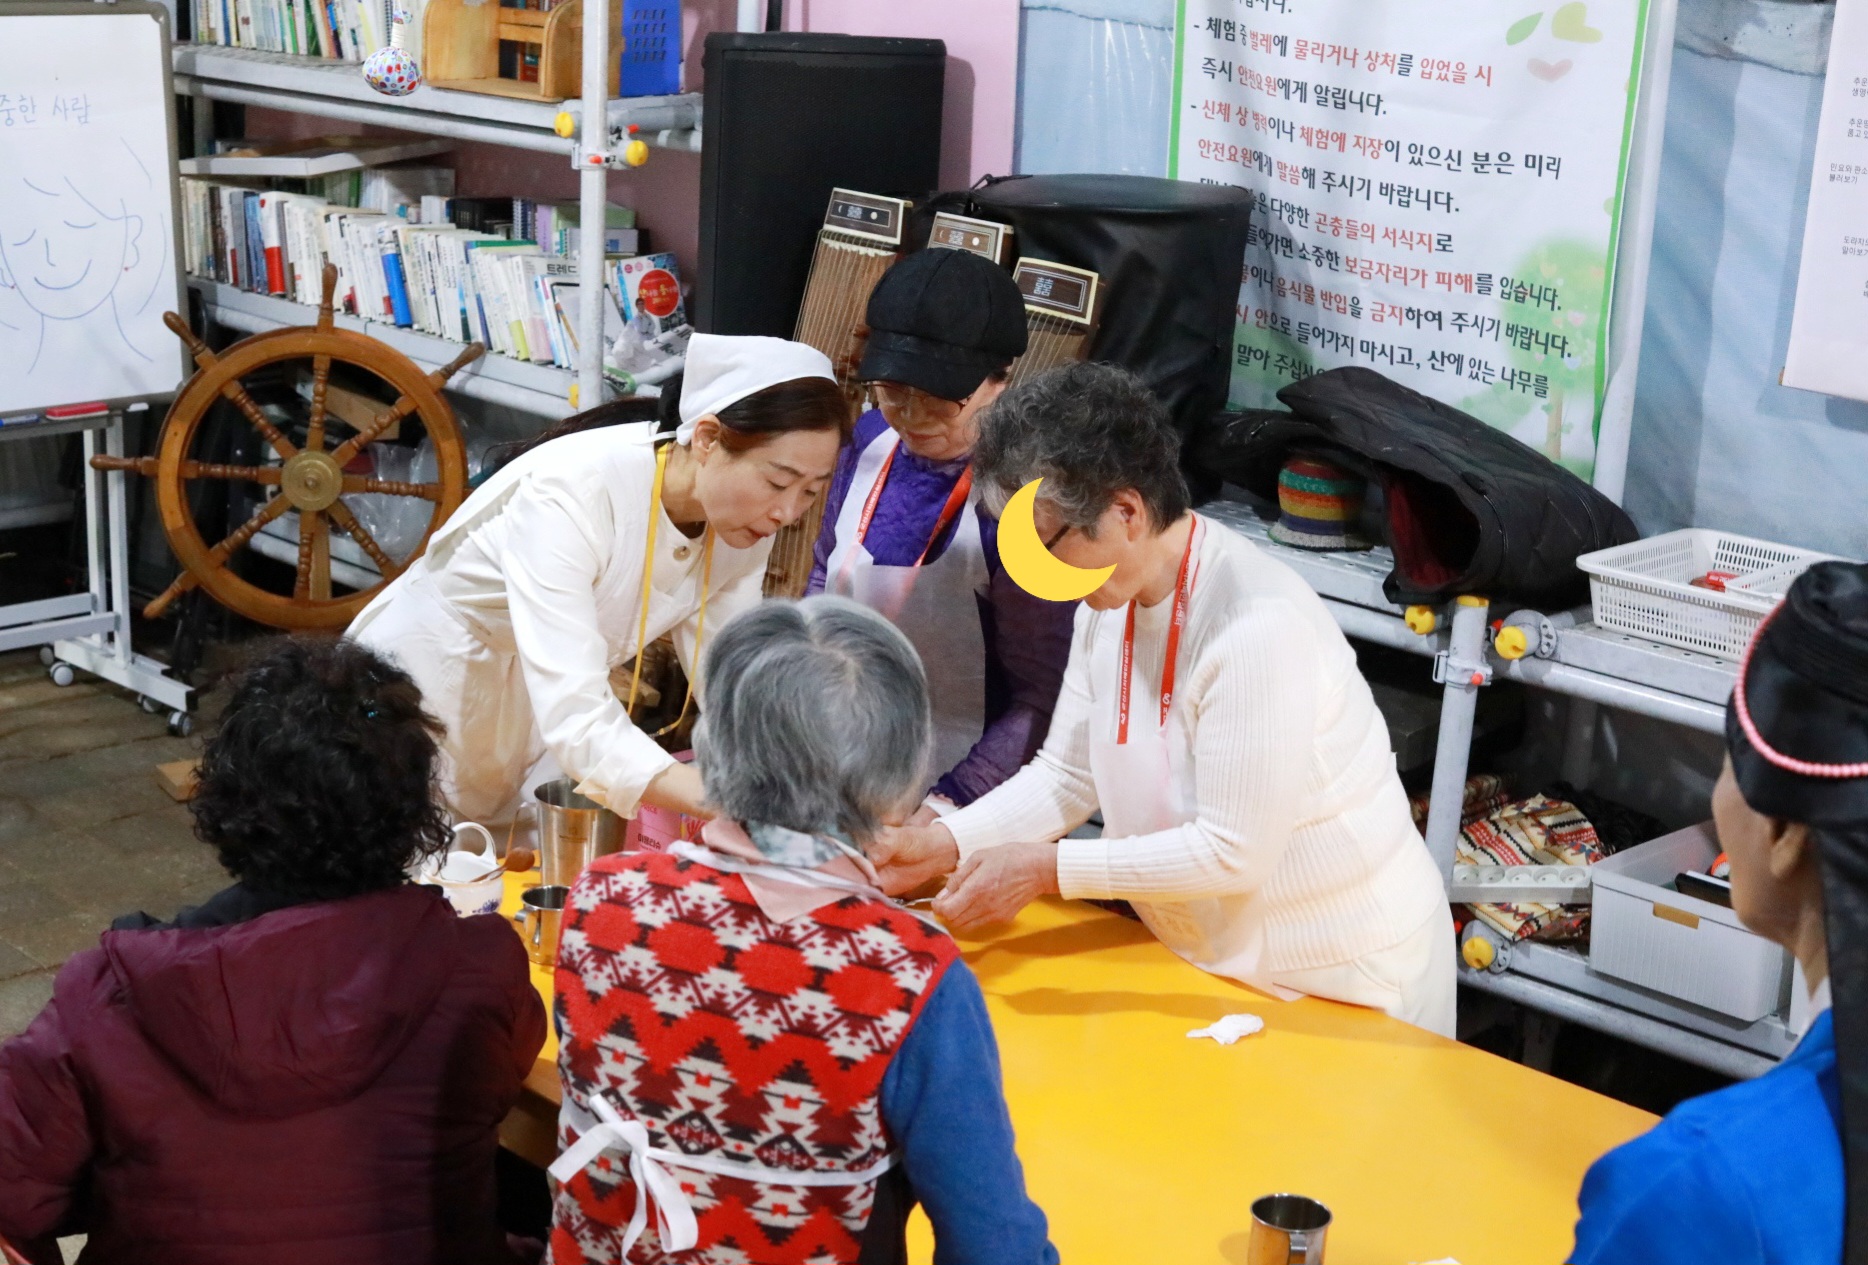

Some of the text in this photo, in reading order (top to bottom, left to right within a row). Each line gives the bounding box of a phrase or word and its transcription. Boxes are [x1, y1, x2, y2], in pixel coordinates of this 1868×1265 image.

[1202, 57, 1387, 116] 즉시 안전요원에게 알립니다.
[1206, 16, 1236, 42] 체험
[1249, 30, 1288, 57] 벌레에
[1294, 38, 1359, 68] 물리거나
[1364, 50, 1413, 77] 상처를
[1420, 58, 1467, 84] 입었을
[1474, 65, 1492, 87] 시
[52, 93, 91, 125] 사람
[1202, 99, 1231, 122] 신체
[1236, 106, 1249, 127] 상
[1299, 125, 1347, 153] 체험에
[1352, 134, 1400, 163] 지장이
[1407, 142, 1462, 173] 있으신
[1471, 151, 1515, 175] 분은
[1524, 154, 1562, 181] 미리
[1198, 138, 1460, 214] 안전요원에게 말씀해 주시기 바랍니다.
[1271, 198, 1310, 229] 다양한
[1315, 212, 1375, 244] 곤충들의
[1382, 226, 1454, 253] 서식지로
[1299, 242, 1340, 272] 소중한
[1345, 256, 1428, 288] 보금자리가
[1435, 271, 1493, 296] 피해를
[1499, 276, 1562, 311] 입습니다.
[1276, 277, 1315, 306] 음식물
[1320, 289, 1363, 319] 반입을
[1370, 300, 1443, 331] 금지하여
[1450, 311, 1501, 342] 주시기
[1505, 322, 1572, 359] 바랍니다.
[1237, 343, 1326, 381] 말아 주십시
[1255, 308, 1292, 336] 안으로
[1296, 321, 1354, 358] 들어가지
[1359, 339, 1421, 370] 마시고,
[1427, 350, 1464, 376] 산에
[1468, 357, 1496, 386] 있는
[1501, 366, 1549, 399] 나무를
